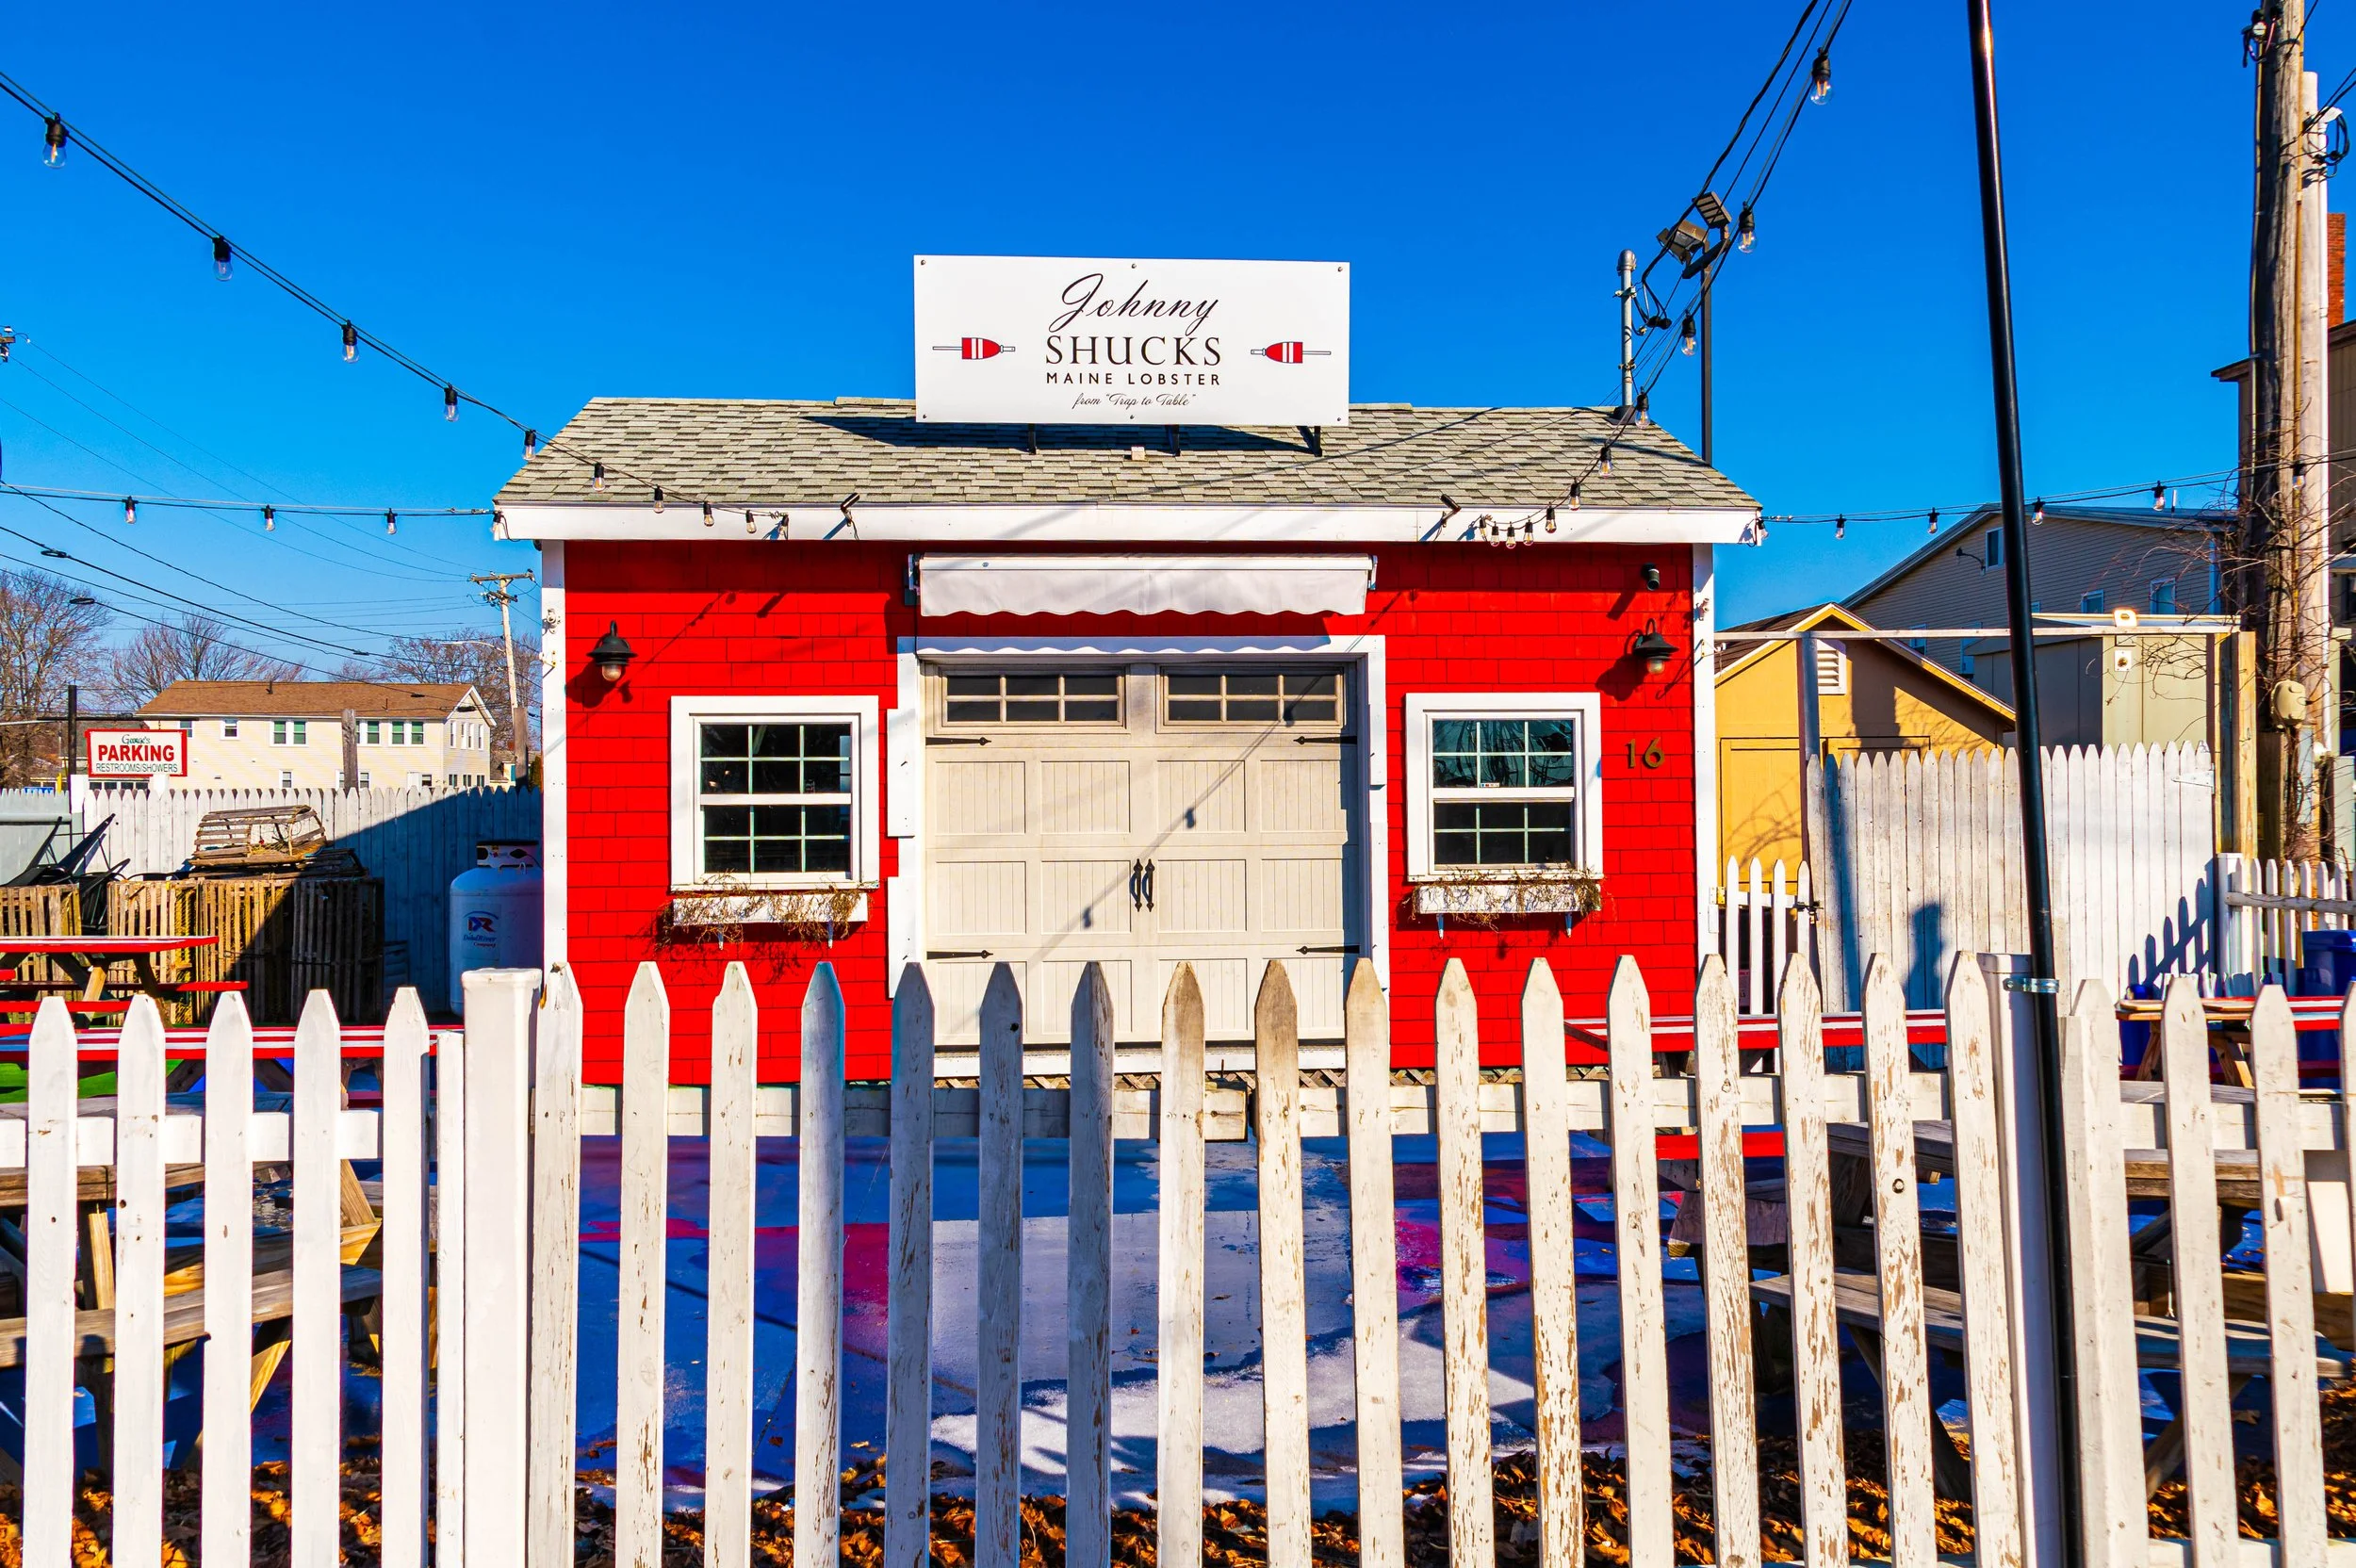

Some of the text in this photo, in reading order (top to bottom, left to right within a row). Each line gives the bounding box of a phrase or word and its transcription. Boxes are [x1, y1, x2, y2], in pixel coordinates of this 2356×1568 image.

[1048, 273, 1219, 336] Johnny
[1046, 335, 1220, 366] SHUCKS
[1046, 372, 1219, 385] MAINE LOBSTER
[1072, 392, 1101, 409] from
[1140, 396, 1153, 406] to
[98, 744, 174, 761] PARKING
[1626, 737, 1665, 769] 16
[96, 763, 178, 773] RESTROOMS/SHOWERS
